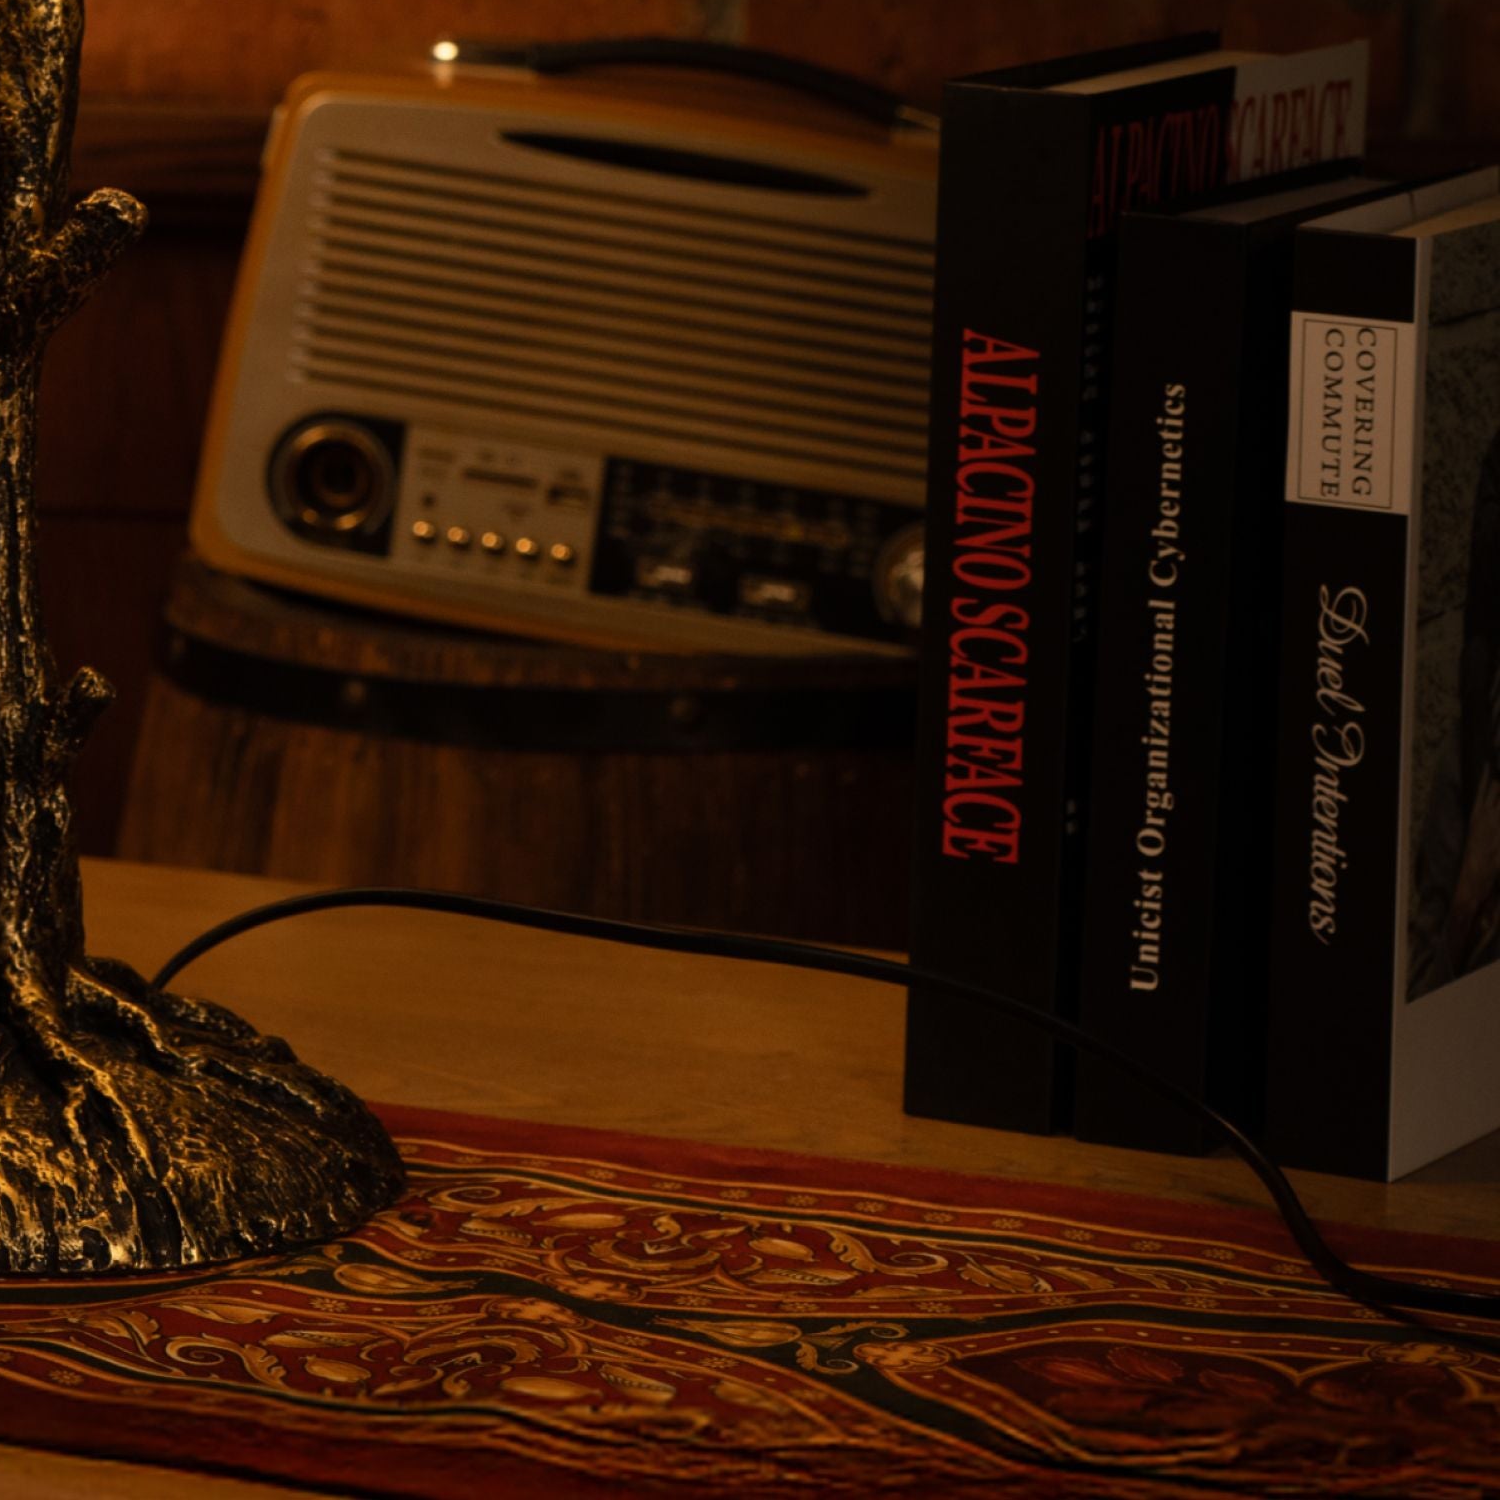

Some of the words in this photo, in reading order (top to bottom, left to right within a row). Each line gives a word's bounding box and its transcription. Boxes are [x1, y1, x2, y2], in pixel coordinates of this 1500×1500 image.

[952, 328, 1041, 590] ALPACINO
[1147, 381, 1188, 589] Cybernetics
[1319, 327, 1345, 498] COMMUTE
[1353, 326, 1377, 498] COVERING
[941, 597, 1031, 865] SCARFACE
[1135, 597, 1178, 858] Organizational
[1313, 585, 1371, 717] Duel
[1129, 867, 1164, 993] Unicist
[1306, 721, 1366, 946] Intentions
